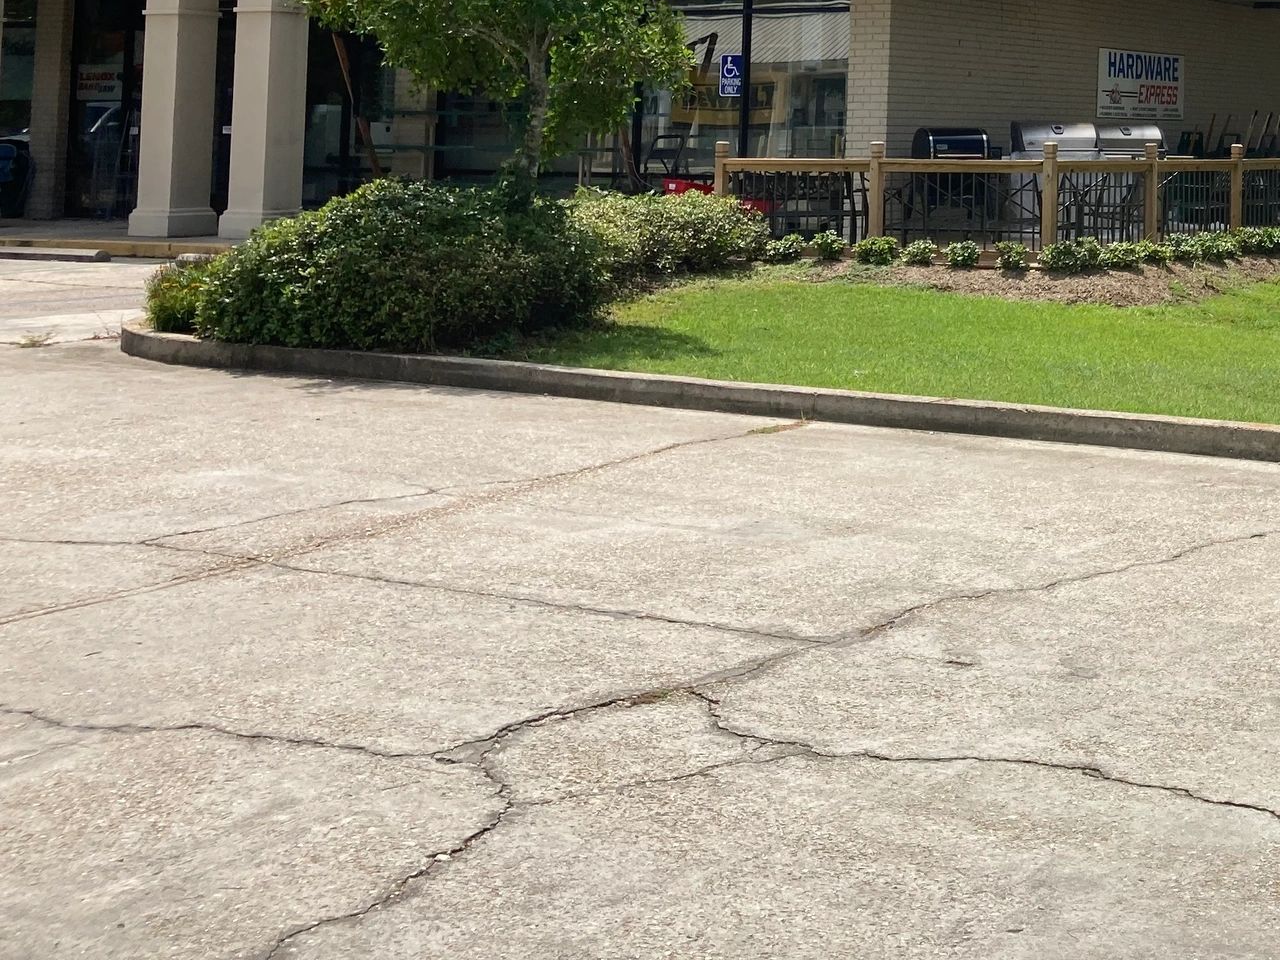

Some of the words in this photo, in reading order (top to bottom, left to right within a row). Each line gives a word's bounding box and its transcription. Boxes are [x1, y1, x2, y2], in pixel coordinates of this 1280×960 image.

[1108, 51, 1179, 82] HARDWARE
[722, 78, 741, 86] PARKING
[1138, 84, 1178, 105] EXPRESS
